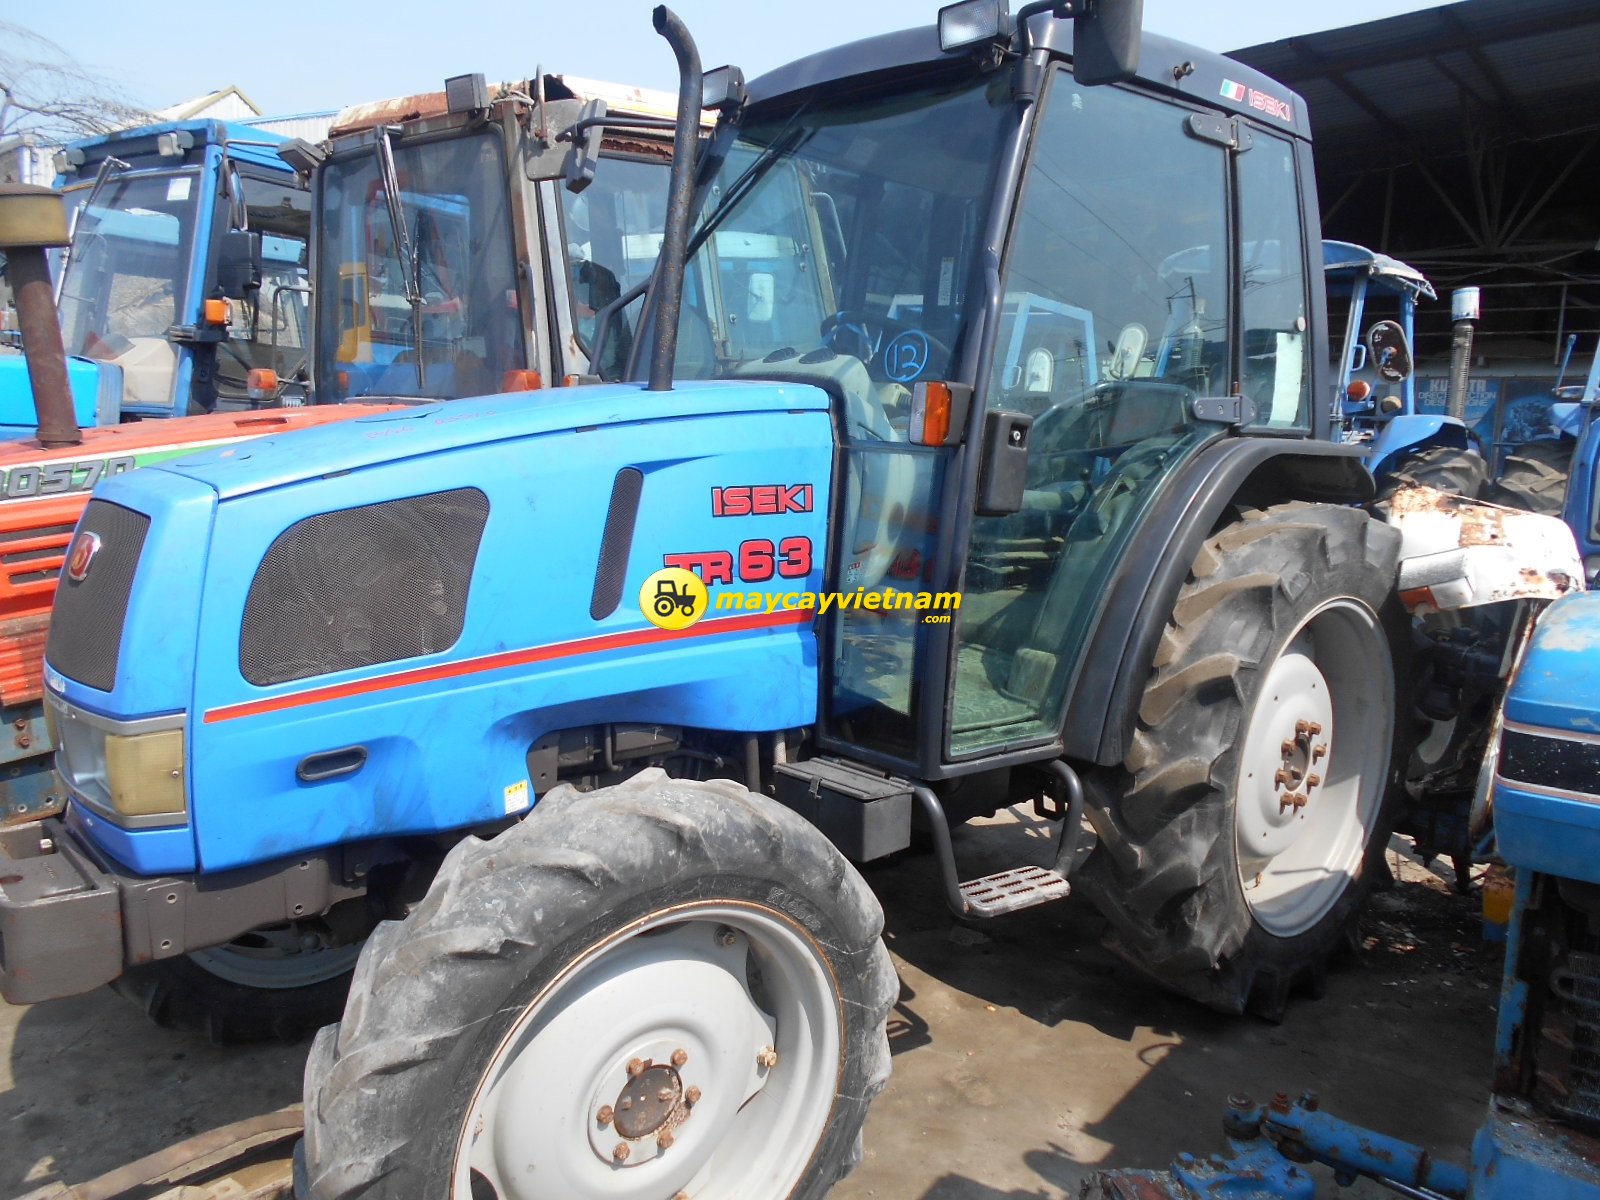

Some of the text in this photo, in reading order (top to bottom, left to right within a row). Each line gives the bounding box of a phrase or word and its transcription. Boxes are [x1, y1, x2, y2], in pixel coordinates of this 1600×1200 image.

[1248, 88, 1291, 122] ISEKI
[893, 344, 920, 374] 12
[1430, 379, 1487, 391] KUTA
[711, 483, 813, 517] ISEKI
